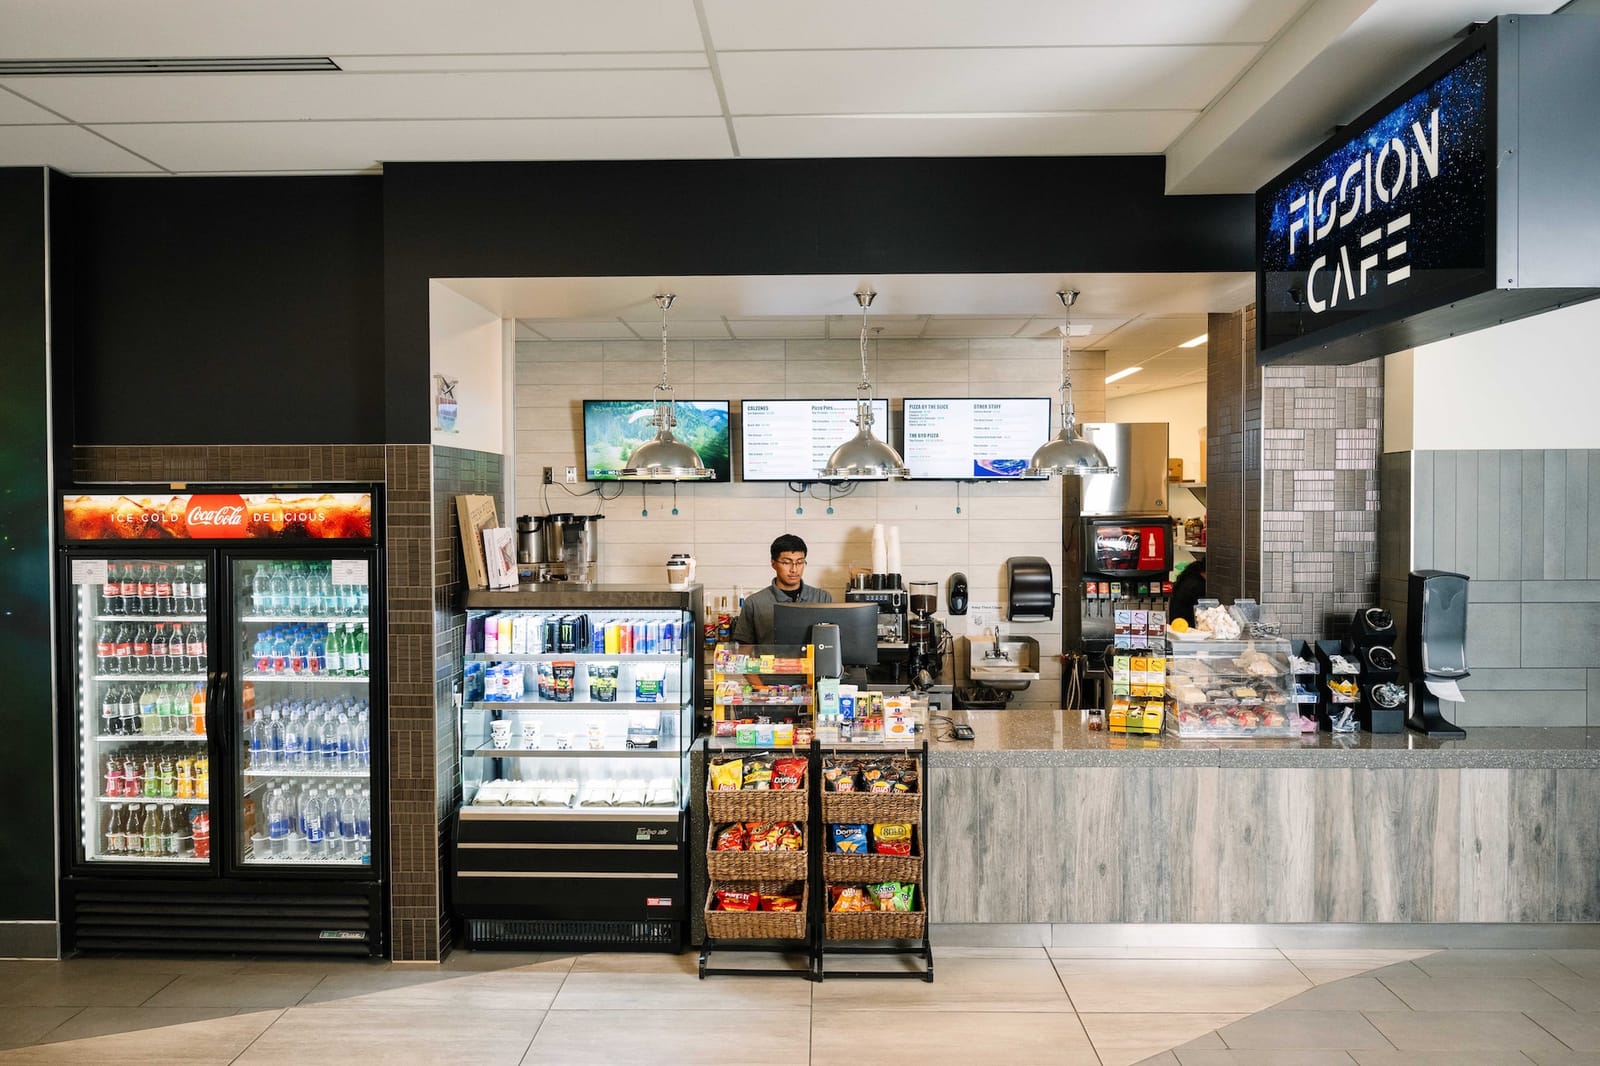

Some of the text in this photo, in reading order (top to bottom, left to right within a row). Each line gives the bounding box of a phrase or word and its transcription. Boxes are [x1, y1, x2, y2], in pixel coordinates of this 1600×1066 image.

[1288, 108, 1439, 255] FISSION
[1307, 212, 1411, 314] CAFE
[111, 513, 179, 523] ICE COLD
[187, 505, 243, 526] Coca-Cola
[253, 512, 326, 523] DELICIOUS
